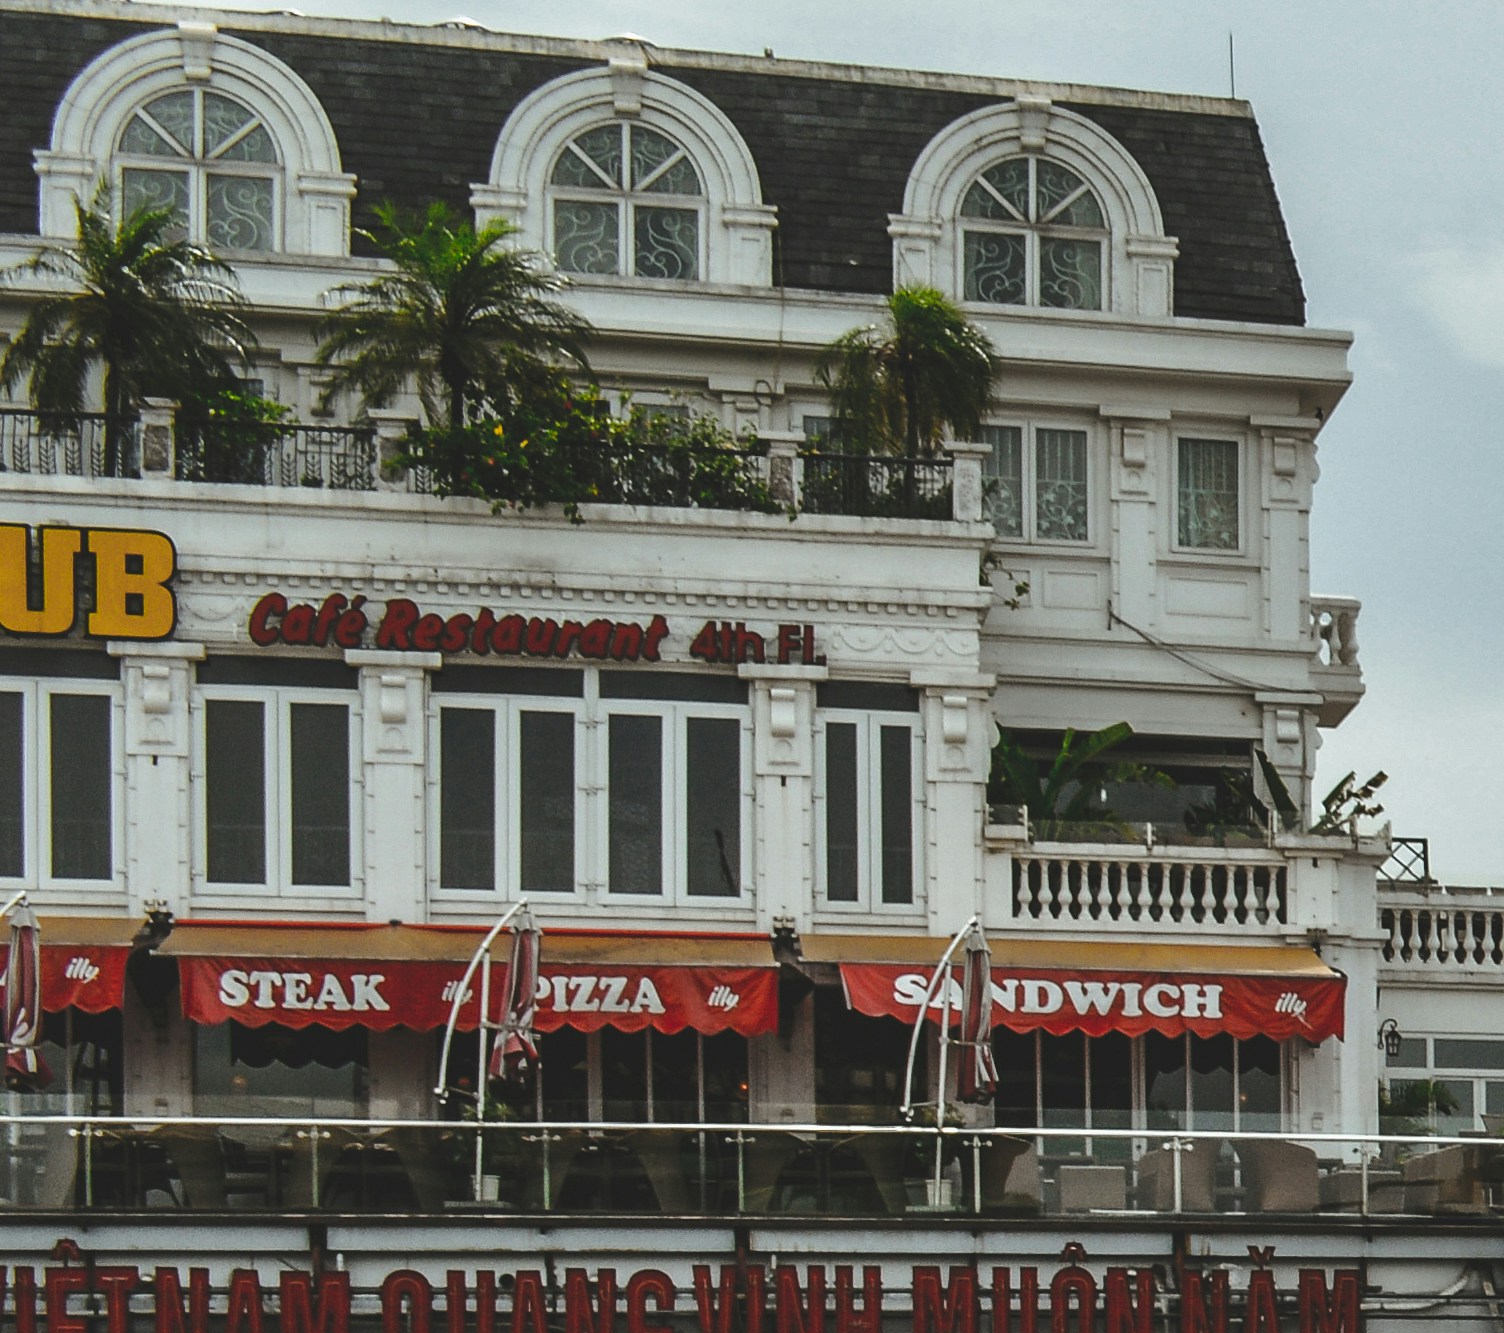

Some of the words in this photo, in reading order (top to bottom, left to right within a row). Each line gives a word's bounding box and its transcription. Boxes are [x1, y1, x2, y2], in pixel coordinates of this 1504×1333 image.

[249, 593, 369, 650] Café
[376, 597, 669, 662] Restaurant
[689, 621, 765, 664] 4th
[65, 956, 99, 984] illy
[219, 969, 390, 1013] STEAK
[708, 986, 739, 1012] illy
[893, 973, 1223, 1018] SANDWICH
[1275, 992, 1306, 1018] illy
